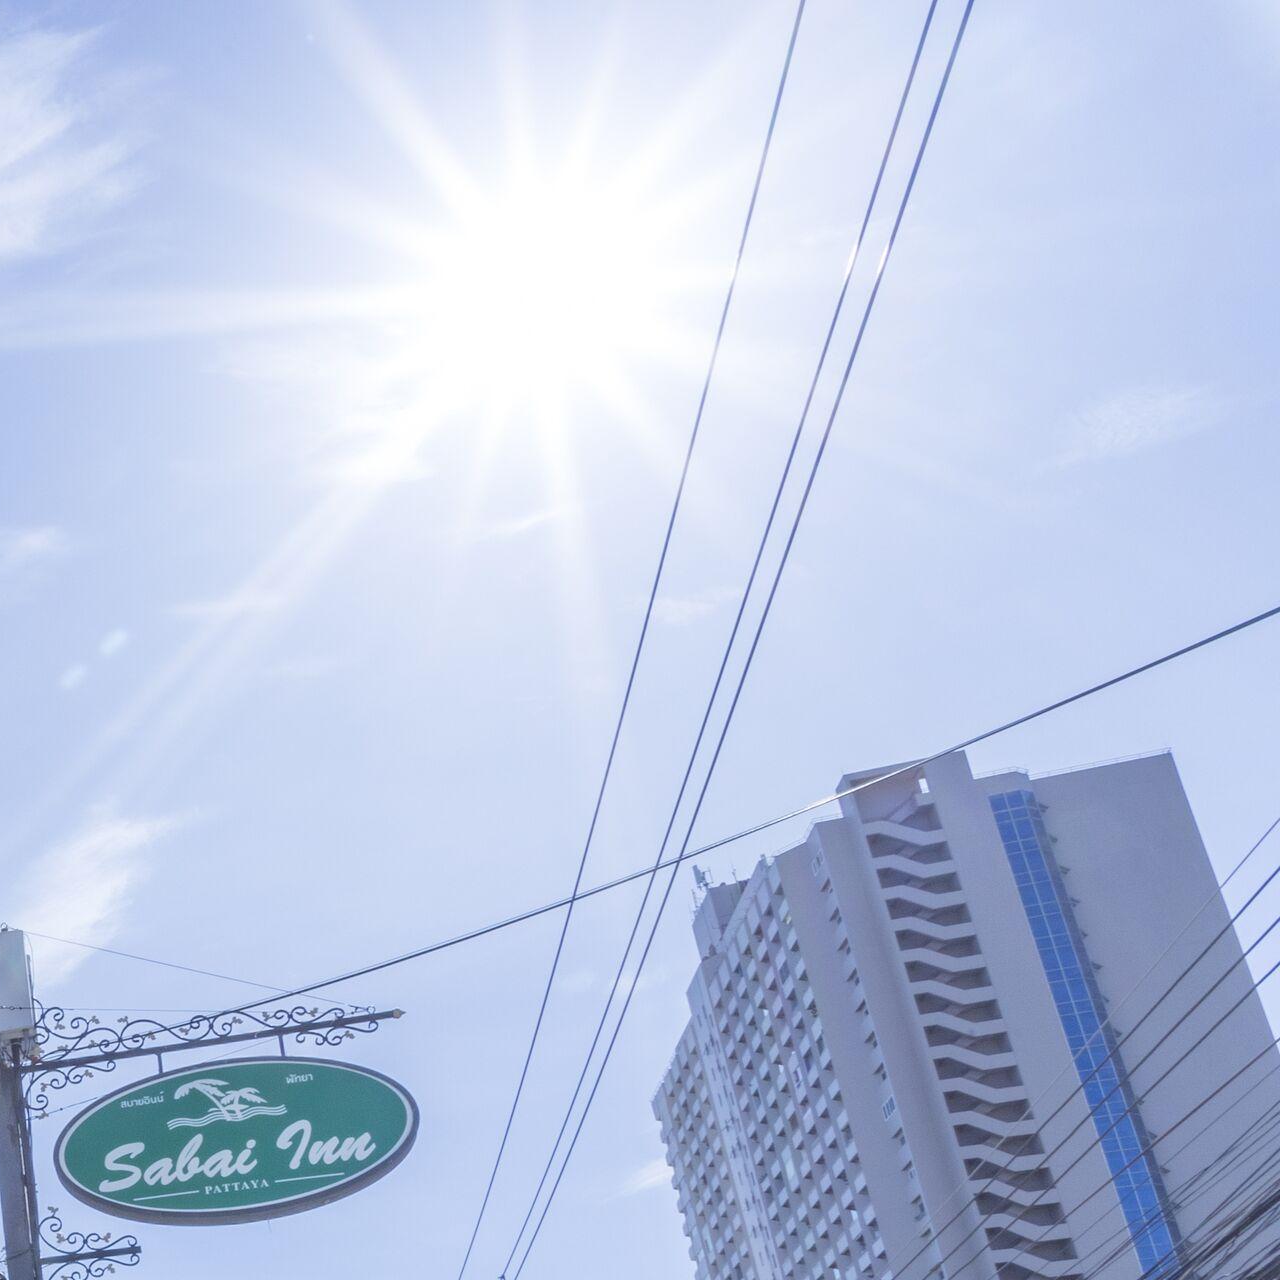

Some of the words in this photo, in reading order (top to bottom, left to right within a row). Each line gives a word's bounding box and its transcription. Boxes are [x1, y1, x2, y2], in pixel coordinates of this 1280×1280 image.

[98, 1133, 259, 1193] Sabai
[275, 1119, 377, 1170] Inn
[204, 1179, 271, 1195] PATTAYA
